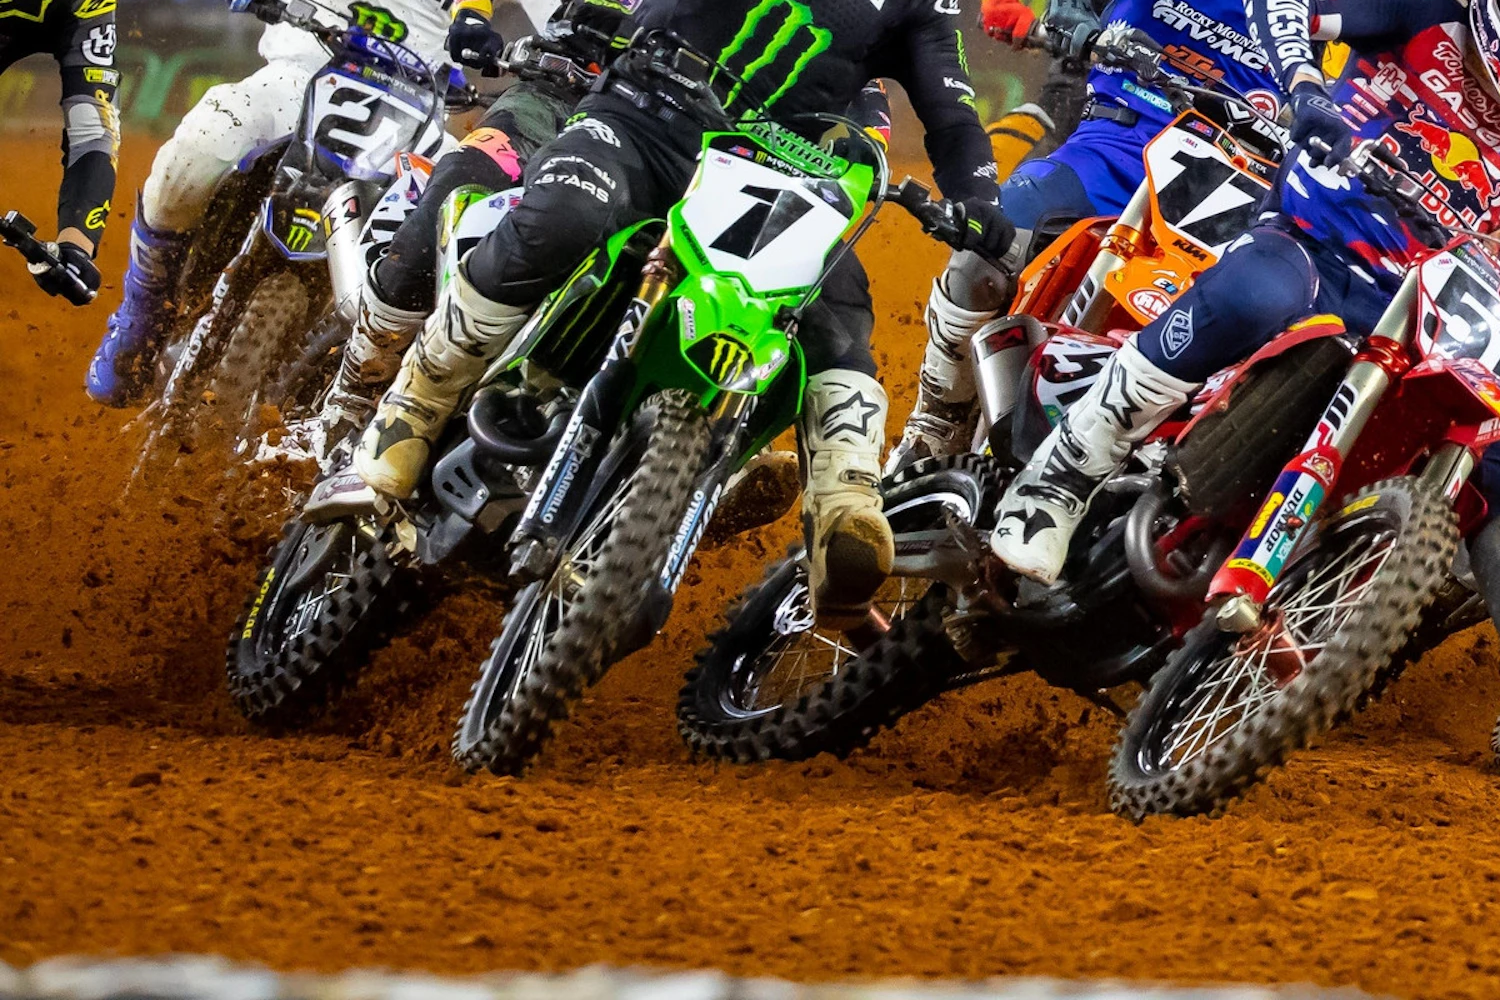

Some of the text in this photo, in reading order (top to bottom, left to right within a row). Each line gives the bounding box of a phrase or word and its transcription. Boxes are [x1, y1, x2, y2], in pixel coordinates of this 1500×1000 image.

[1175, 0, 1215, 28] ROCKY
[1161, 44, 1226, 80] KTM
[1378, 65, 1403, 90] PPG
[1132, 81, 1175, 113] MOTOREX
[1170, 149, 1275, 249] 17
[680, 223, 707, 266] Kawasaki
[1172, 238, 1209, 263] KTM
[541, 461, 580, 524] CARRILLO
[670, 489, 705, 555] CARRILLO
